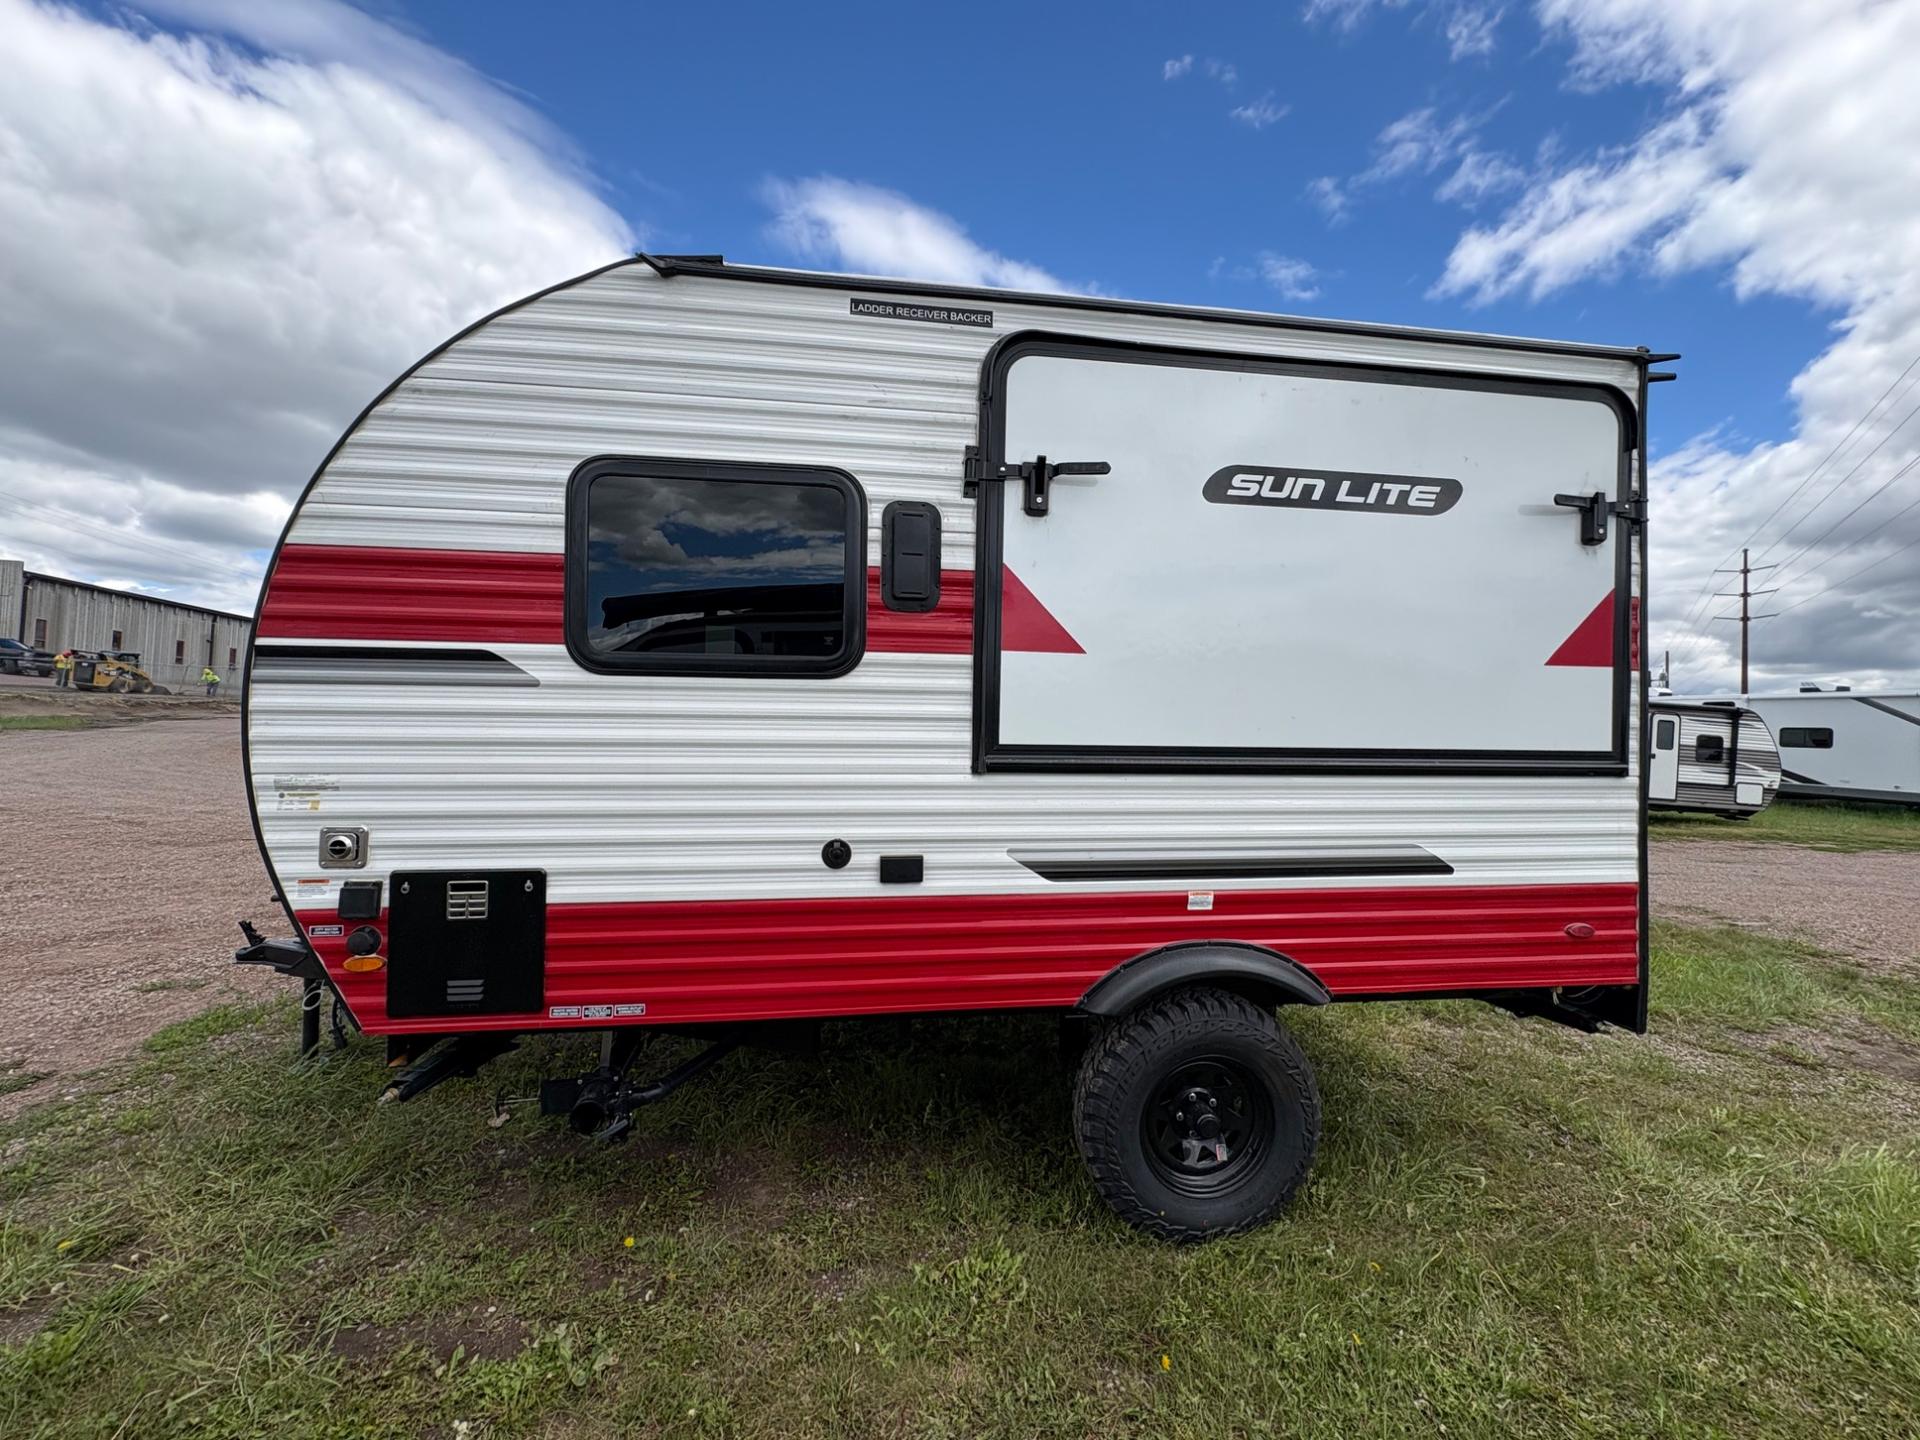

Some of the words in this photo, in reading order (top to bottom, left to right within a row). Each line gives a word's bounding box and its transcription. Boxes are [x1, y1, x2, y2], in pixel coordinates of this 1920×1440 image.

[851, 302, 894, 315] LADDER
[896, 307, 948, 320] RECEIVER
[950, 311, 992, 323] BACKER
[1226, 473, 1326, 501] SUN
[1335, 480, 1442, 508] LITE
